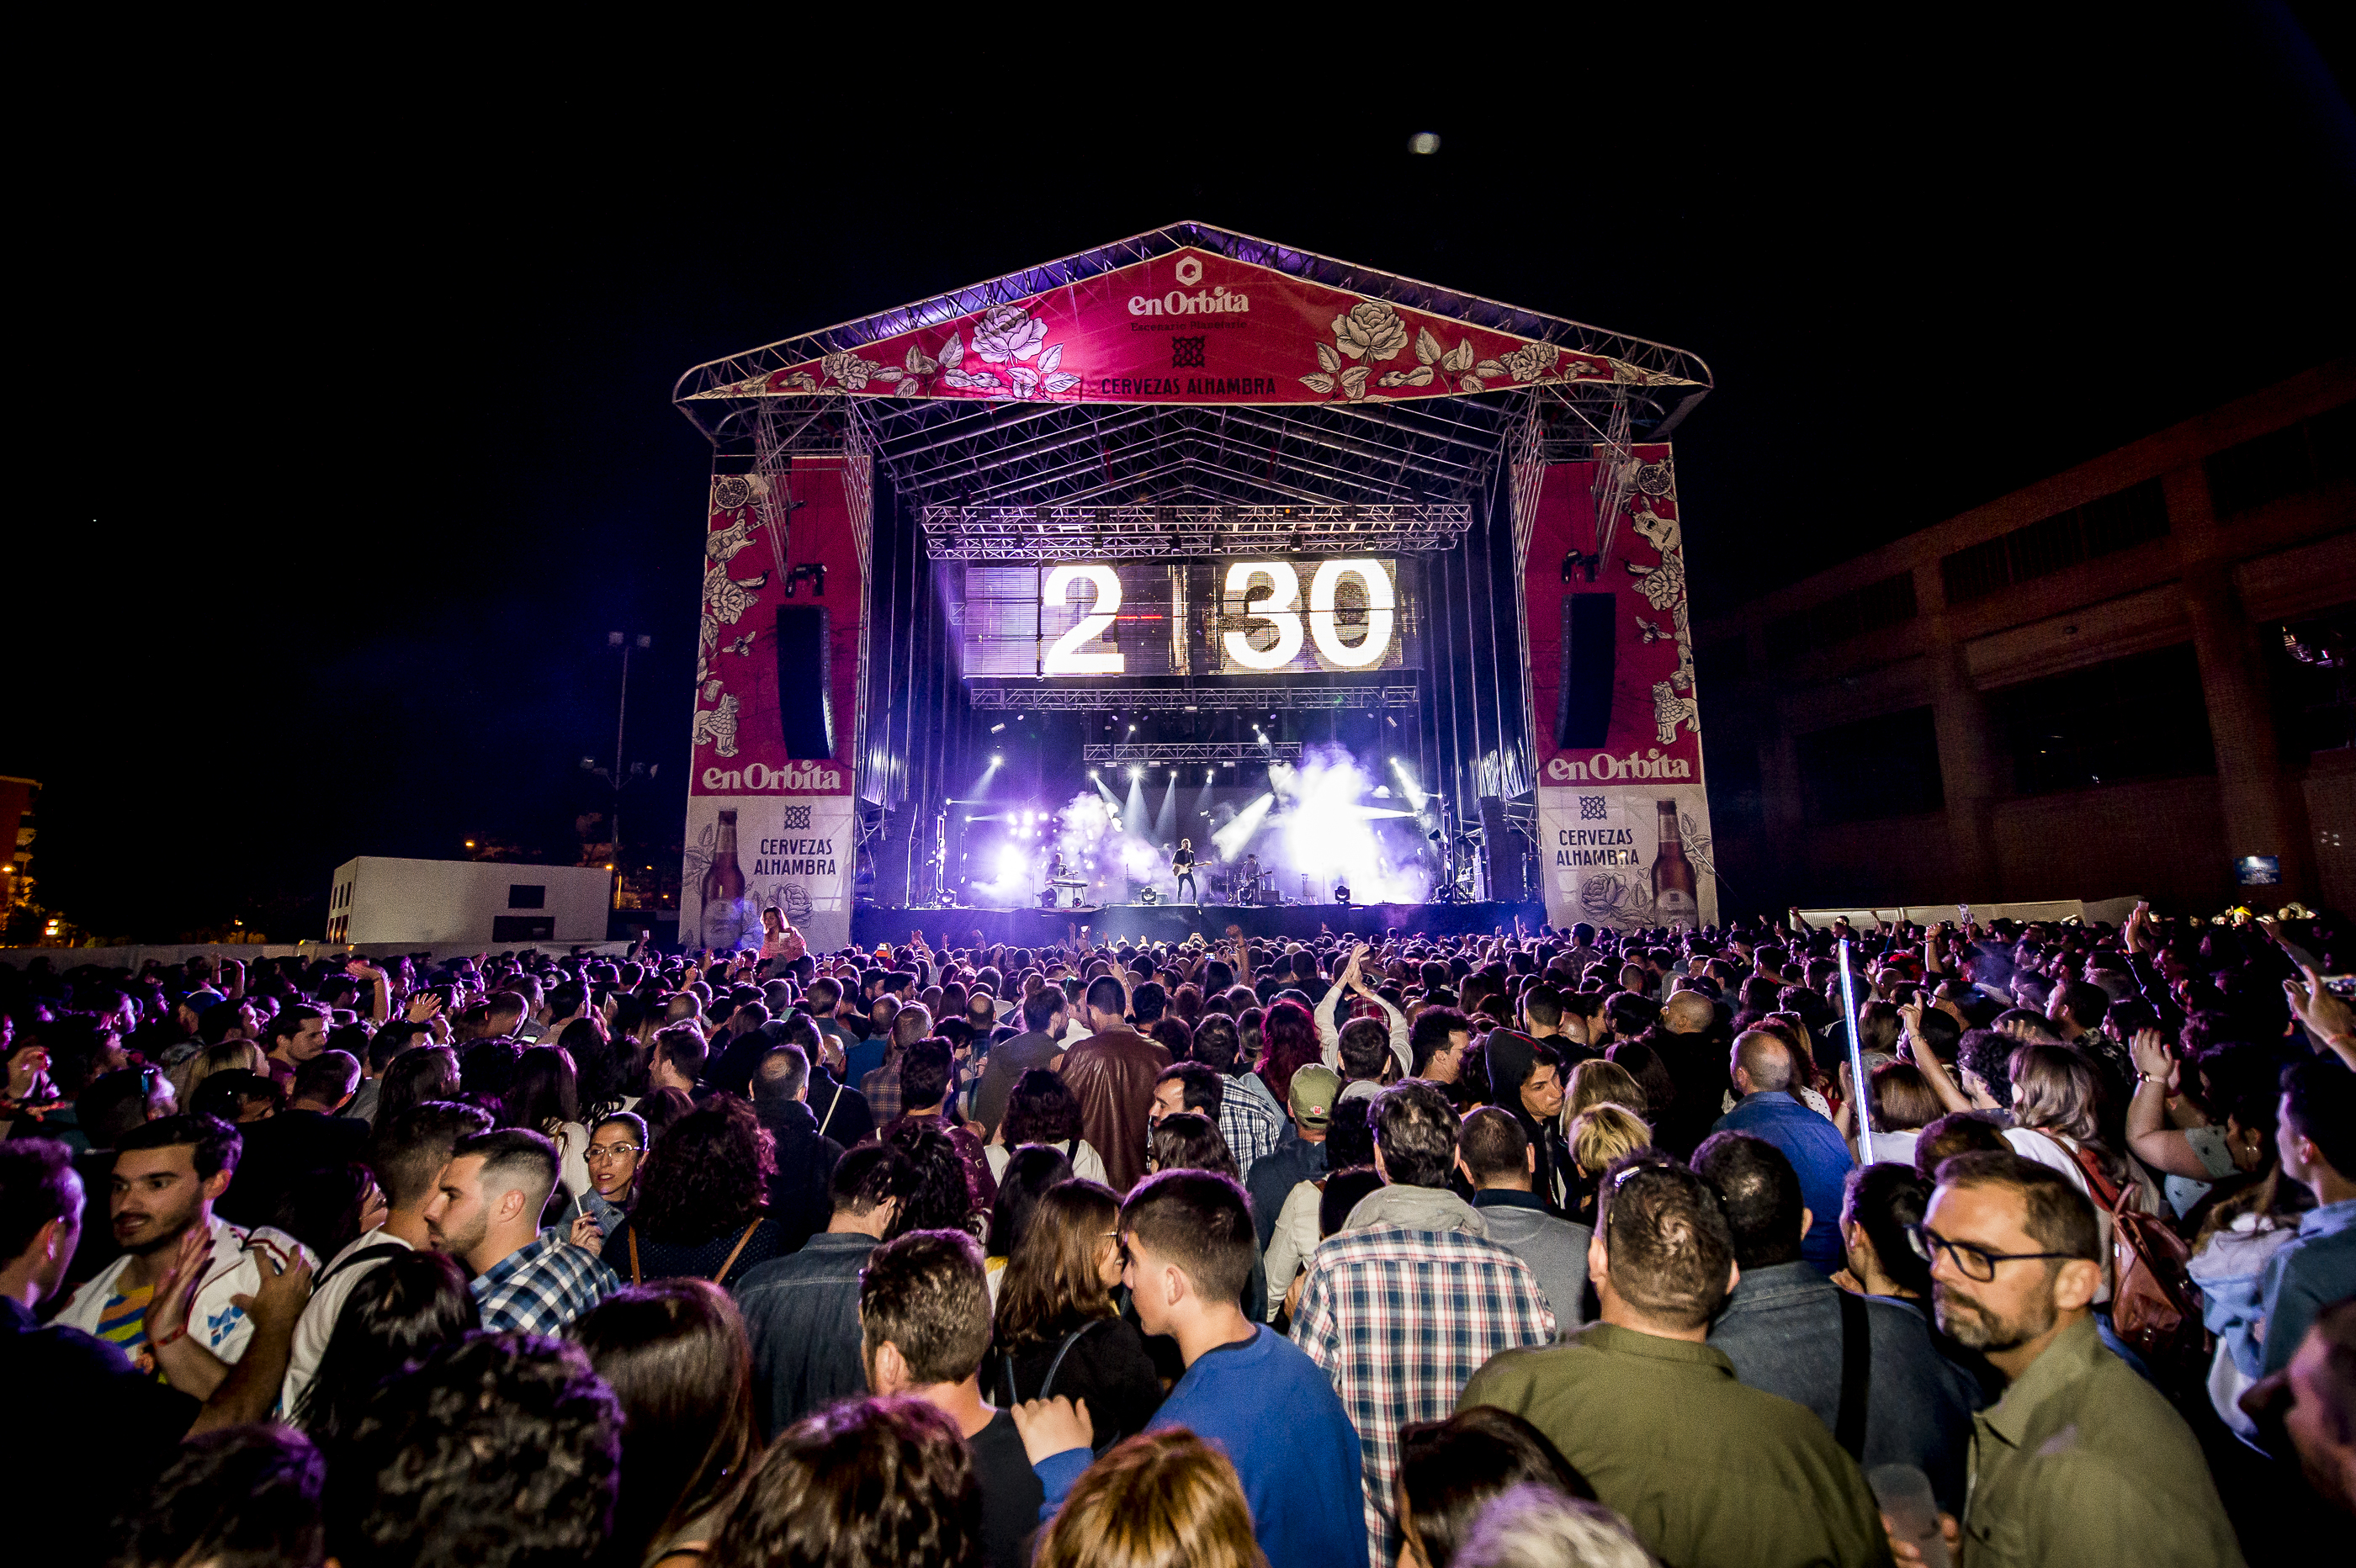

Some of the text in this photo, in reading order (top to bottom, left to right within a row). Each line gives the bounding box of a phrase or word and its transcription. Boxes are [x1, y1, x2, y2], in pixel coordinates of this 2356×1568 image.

[1101, 378, 1276, 395] CERVEZAS ALHAMBRA
[1043, 559, 1395, 674] 2 30
[1559, 829, 1633, 845] CERVEZAS
[760, 839, 833, 856] CERVEZAS
[1557, 849, 1640, 866] ALHAMBRA
[754, 859, 836, 876] ALHAMBRA
